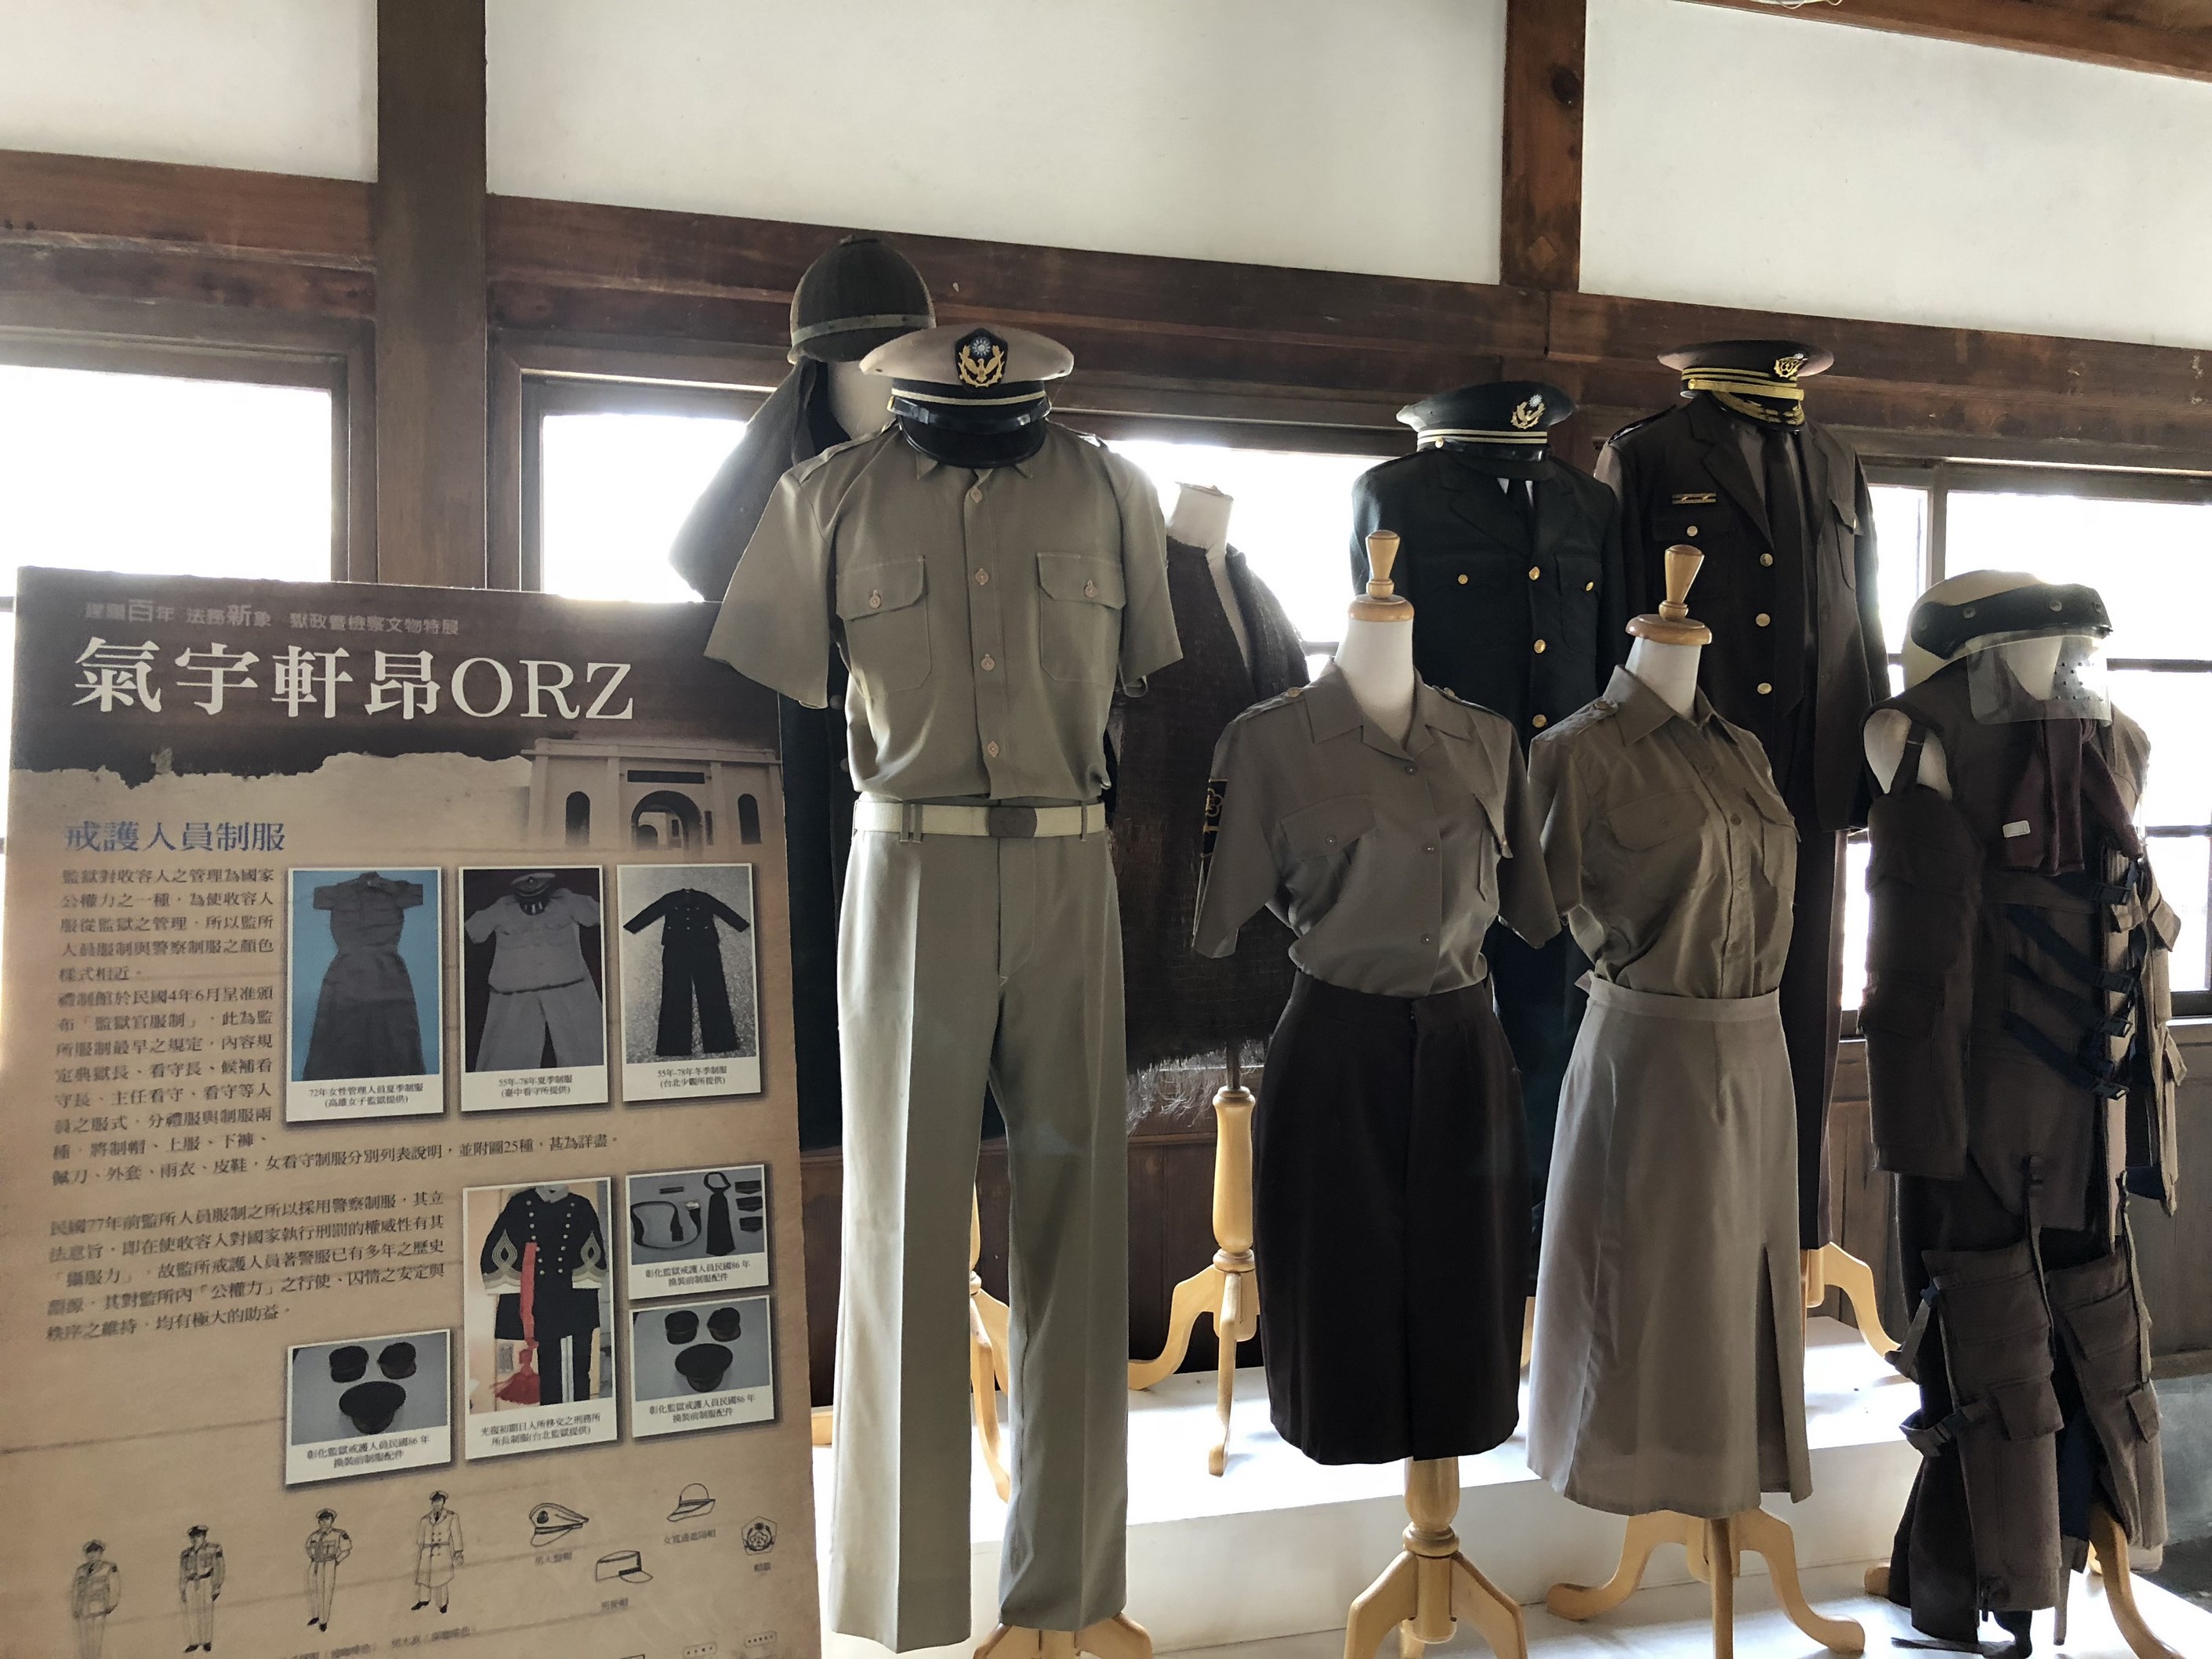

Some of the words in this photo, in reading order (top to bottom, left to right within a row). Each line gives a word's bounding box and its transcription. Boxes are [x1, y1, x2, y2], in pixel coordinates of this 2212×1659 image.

[186, 603, 271, 628] 法務新象
[72, 636, 634, 721] 氣宇軒昂ORZ
[63, 820, 286, 853] 戒護人員制服
